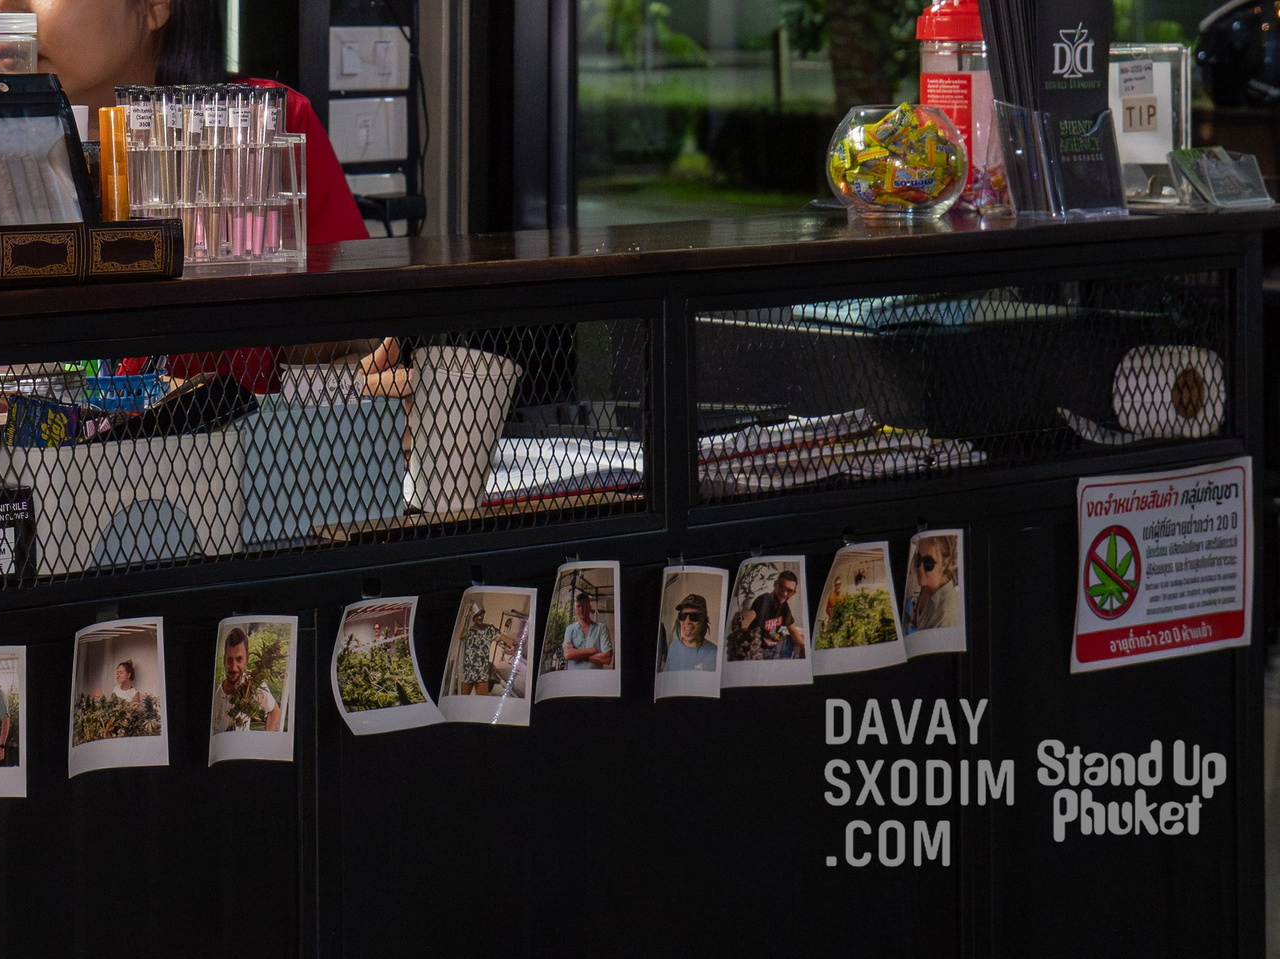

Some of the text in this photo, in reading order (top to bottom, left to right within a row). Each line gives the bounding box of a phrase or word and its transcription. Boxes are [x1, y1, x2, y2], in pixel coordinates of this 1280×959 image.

[1125, 104, 1157, 127] TIP
[1087, 481, 1239, 518] งดจำหน่ายสินค้า กลุ่มกัญชา
[1216, 514, 1229, 531] 20
[1231, 511, 1238, 530] ปี
[1158, 630, 1172, 644] 20
[1172, 626, 1181, 642] ปี
